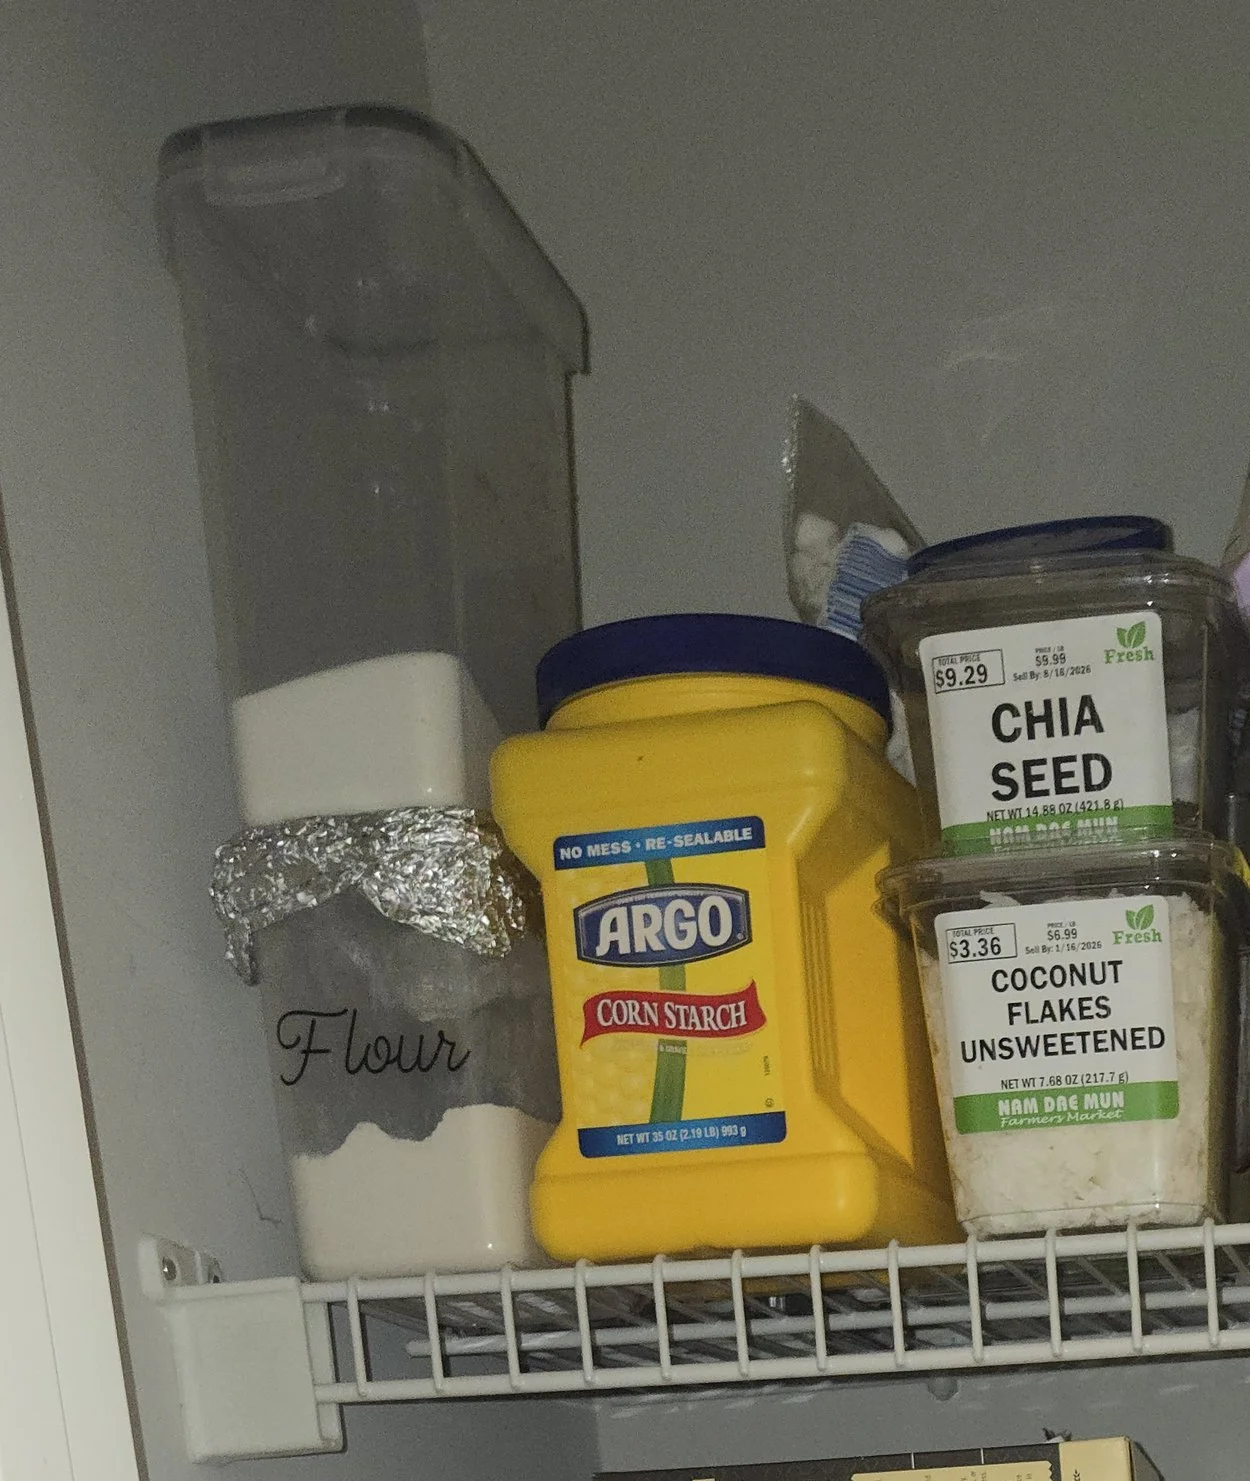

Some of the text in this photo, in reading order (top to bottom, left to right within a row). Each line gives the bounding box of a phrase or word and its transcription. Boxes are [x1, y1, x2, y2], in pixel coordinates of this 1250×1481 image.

[1035, 653, 1066, 667] $9.99
[1104, 648, 1154, 664] Fresh
[936, 664, 988, 688] $9.29
[992, 695, 1104, 743] CHIA
[992, 753, 1113, 802] SEED
[560, 827, 752, 860] NO MESS RE-SEALABLE
[596, 895, 733, 957] ARGO
[1047, 928, 1078, 941] $6.99
[1112, 929, 1163, 945] Fresh
[949, 936, 1002, 959] $3.36
[991, 959, 1123, 993] COCONUT
[597, 999, 747, 1032] CORN STARCH
[1007, 996, 1112, 1026] FLAKES
[275, 1007, 471, 1087] Flour
[961, 1026, 1165, 1064] UNSWEETENED
[1001, 1071, 1128, 1091] NET WT 7.68 OZ (217.7 g)
[998, 1091, 1125, 1117] NAM DAE MUN
[1001, 1108, 1121, 1128] Farmers Market
